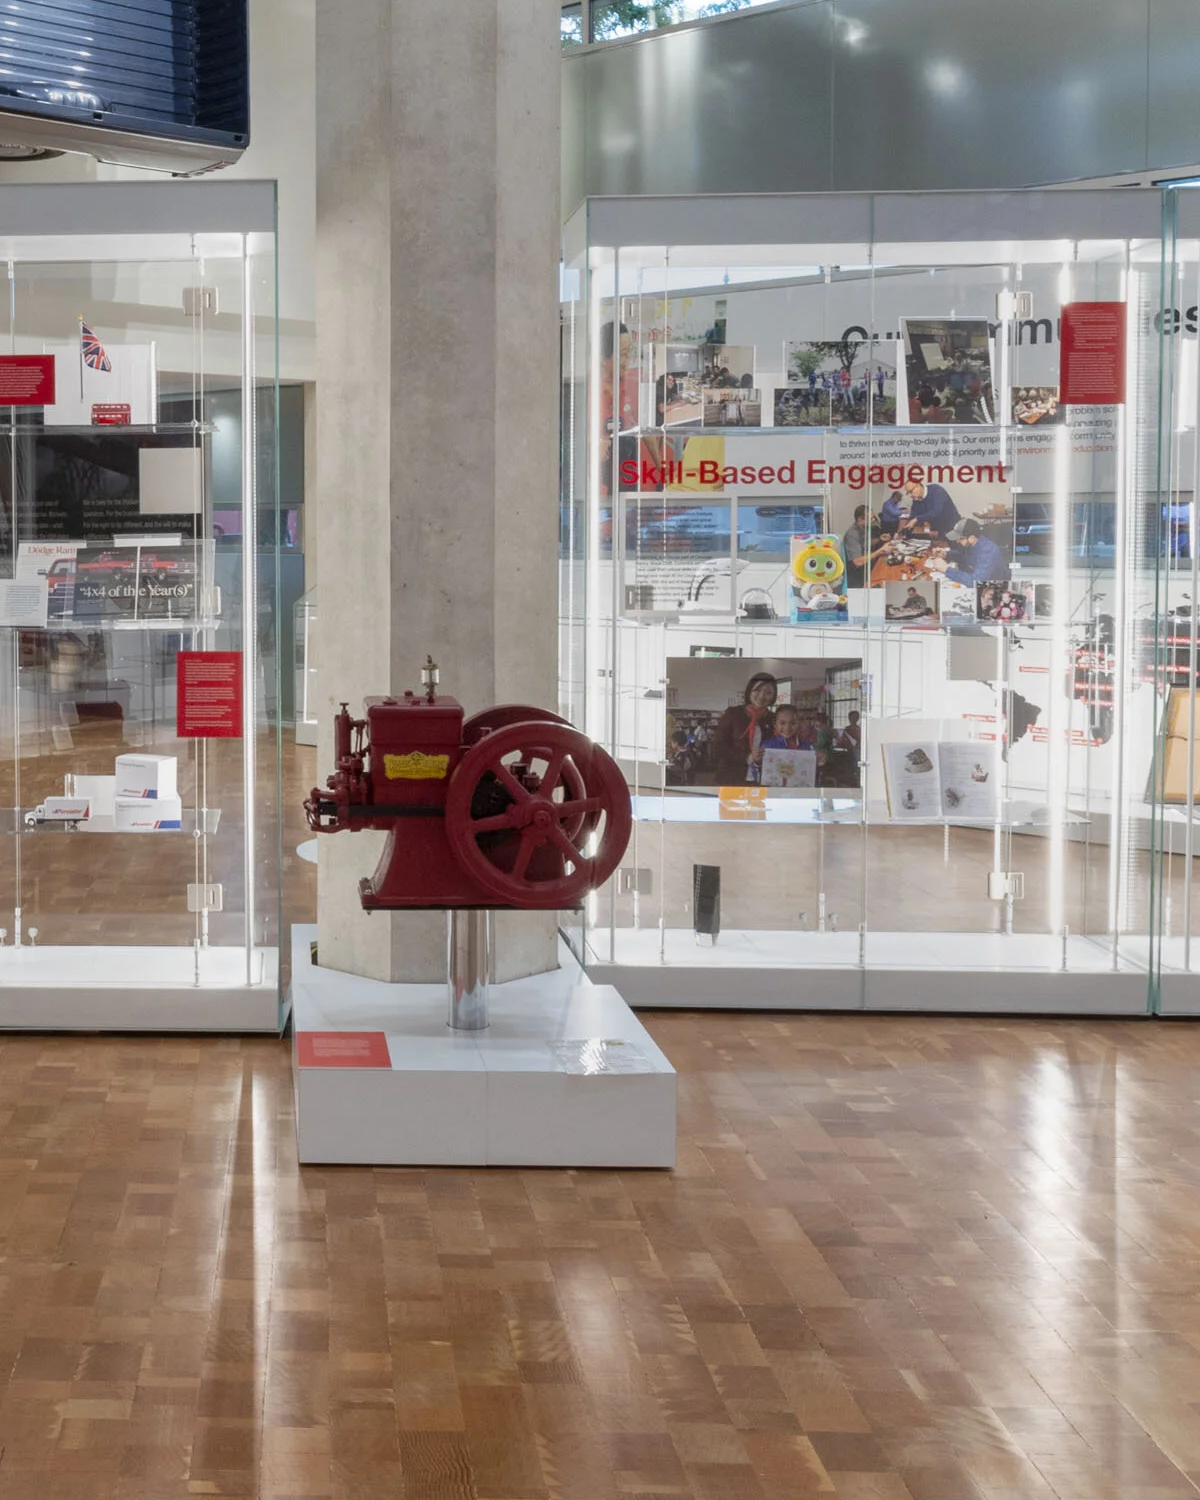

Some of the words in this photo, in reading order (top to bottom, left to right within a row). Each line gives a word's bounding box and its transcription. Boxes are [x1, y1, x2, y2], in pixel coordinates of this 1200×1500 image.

[879, 437, 895, 447] their
[897, 435, 938, 447] day-to-day
[962, 435, 977, 444] Our
[840, 451, 865, 459] around
[881, 449, 901, 458] world
[911, 448, 931, 457] three
[958, 446, 986, 457] priority
[620, 460, 796, 486] Skill-Based
[807, 460, 1007, 491] Engagement
[28, 545, 52, 557] Dodge
[108, 584, 122, 597] of
[123, 583, 146, 597] the
